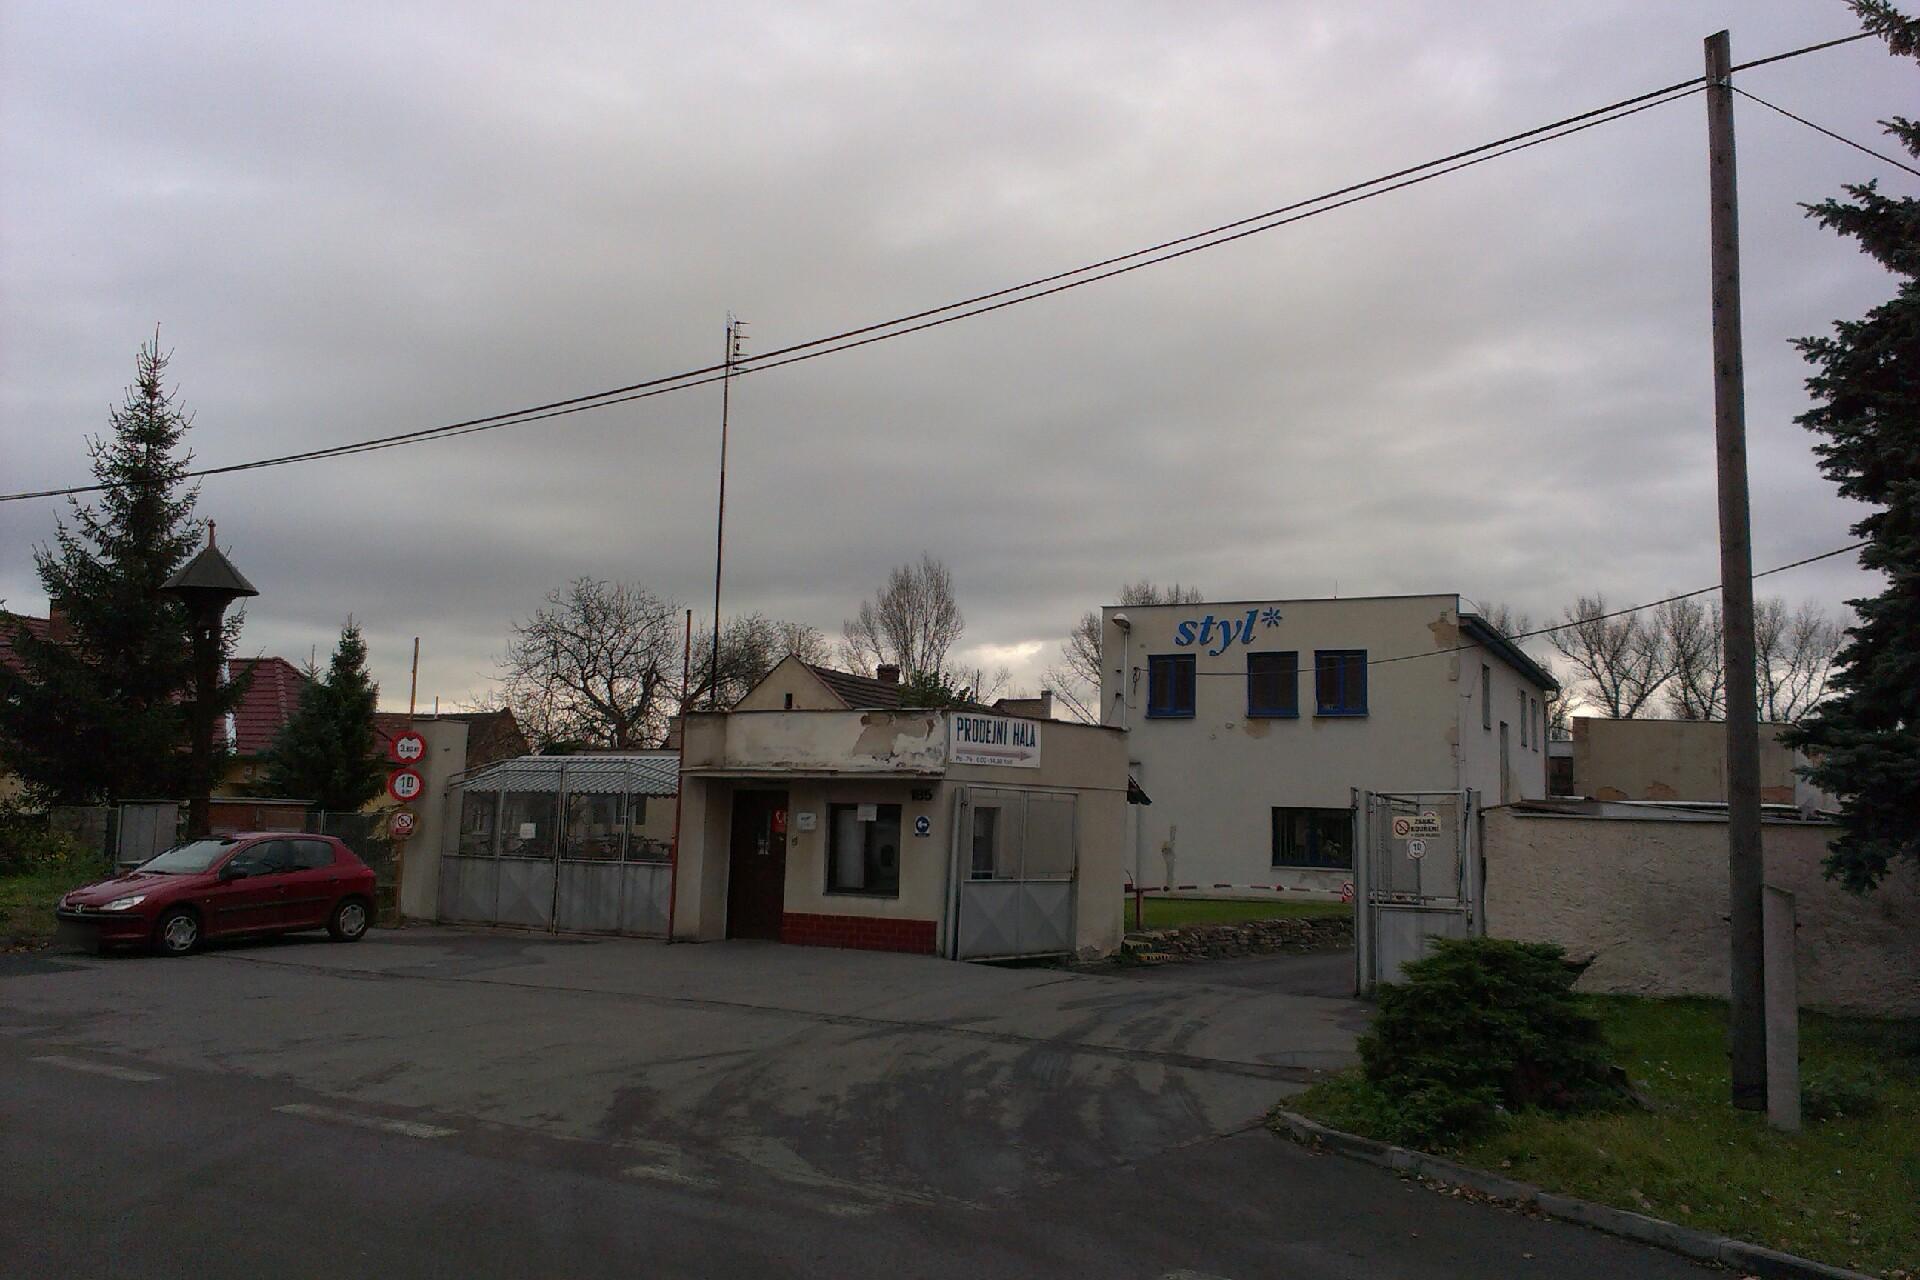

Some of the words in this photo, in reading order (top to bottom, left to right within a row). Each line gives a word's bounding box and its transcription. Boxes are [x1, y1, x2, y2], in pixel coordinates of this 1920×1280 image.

[1175, 609, 1259, 656] styl
[1013, 721, 1036, 748] HALA
[401, 776, 414, 788] 10
